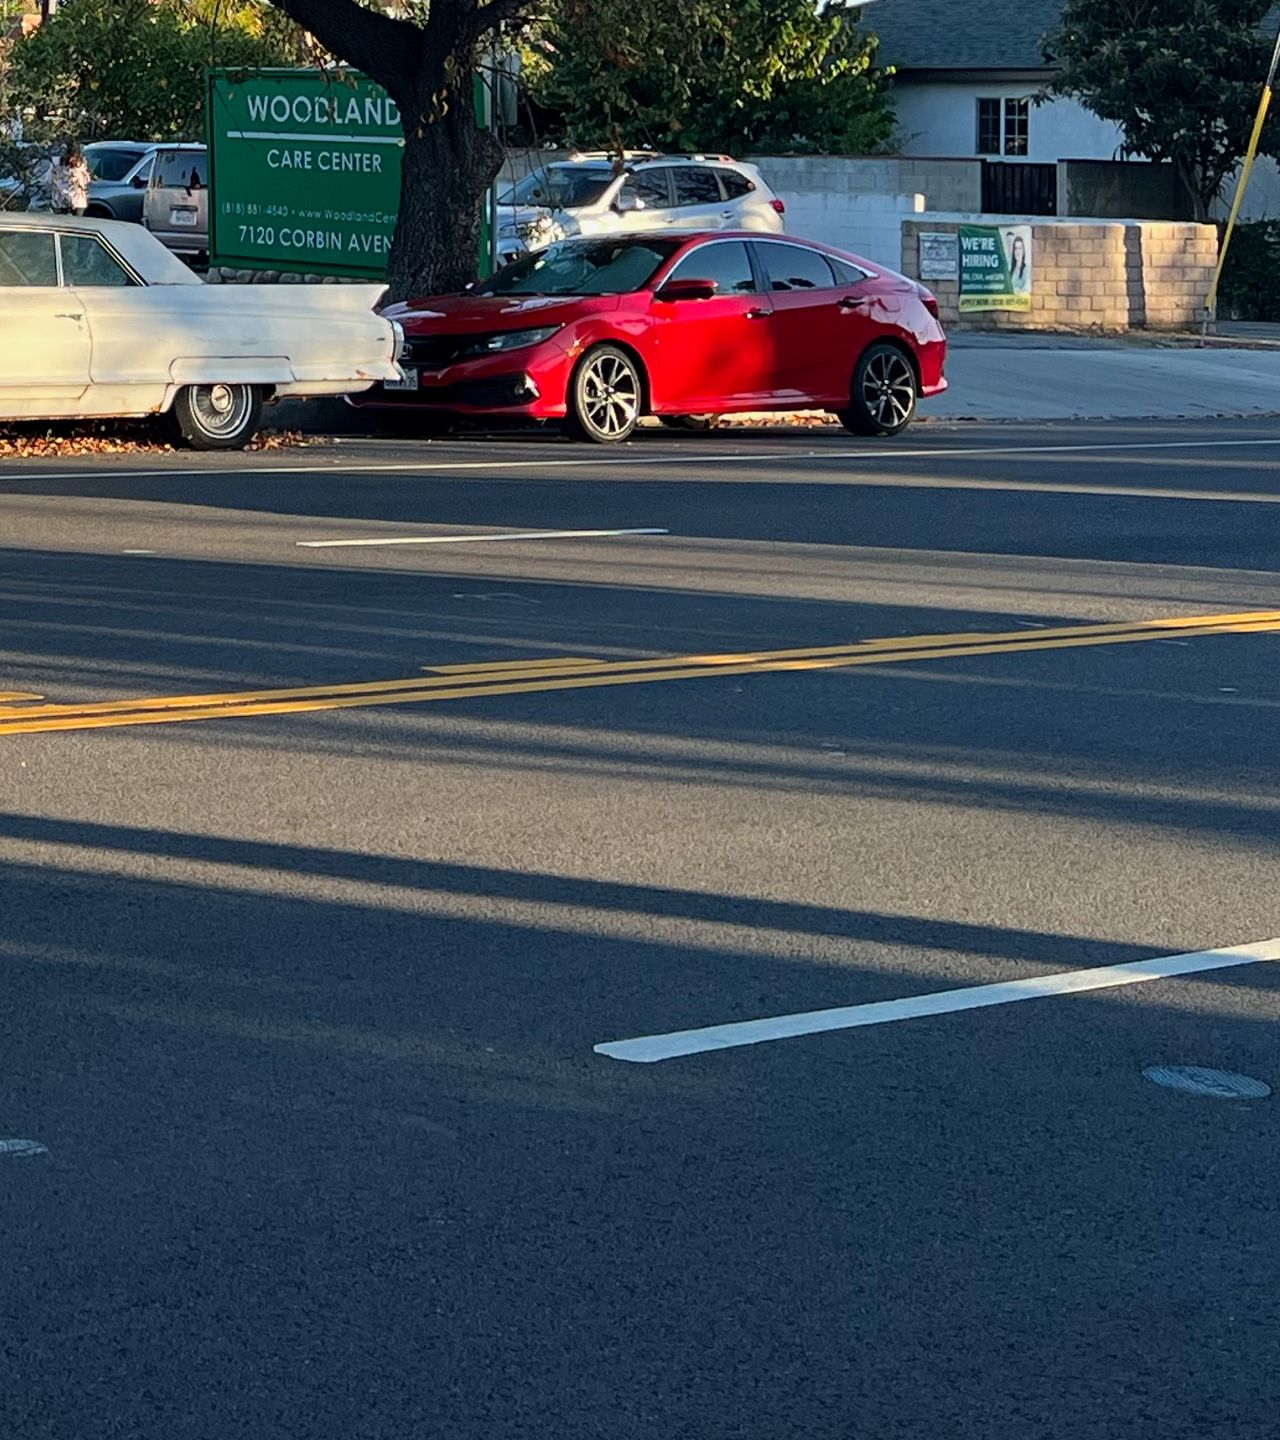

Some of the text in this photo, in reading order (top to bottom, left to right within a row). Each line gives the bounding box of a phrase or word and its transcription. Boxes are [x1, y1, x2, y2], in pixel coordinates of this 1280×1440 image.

[247, 95, 401, 126] WOODLAND
[267, 149, 382, 173] CARE CENTER
[221, 202, 245, 215] (818)
[238, 225, 275, 245] 7120
[279, 228, 342, 251] CORBIN
[961, 237, 995, 251] WE'RE
[962, 254, 999, 268] HIRING
